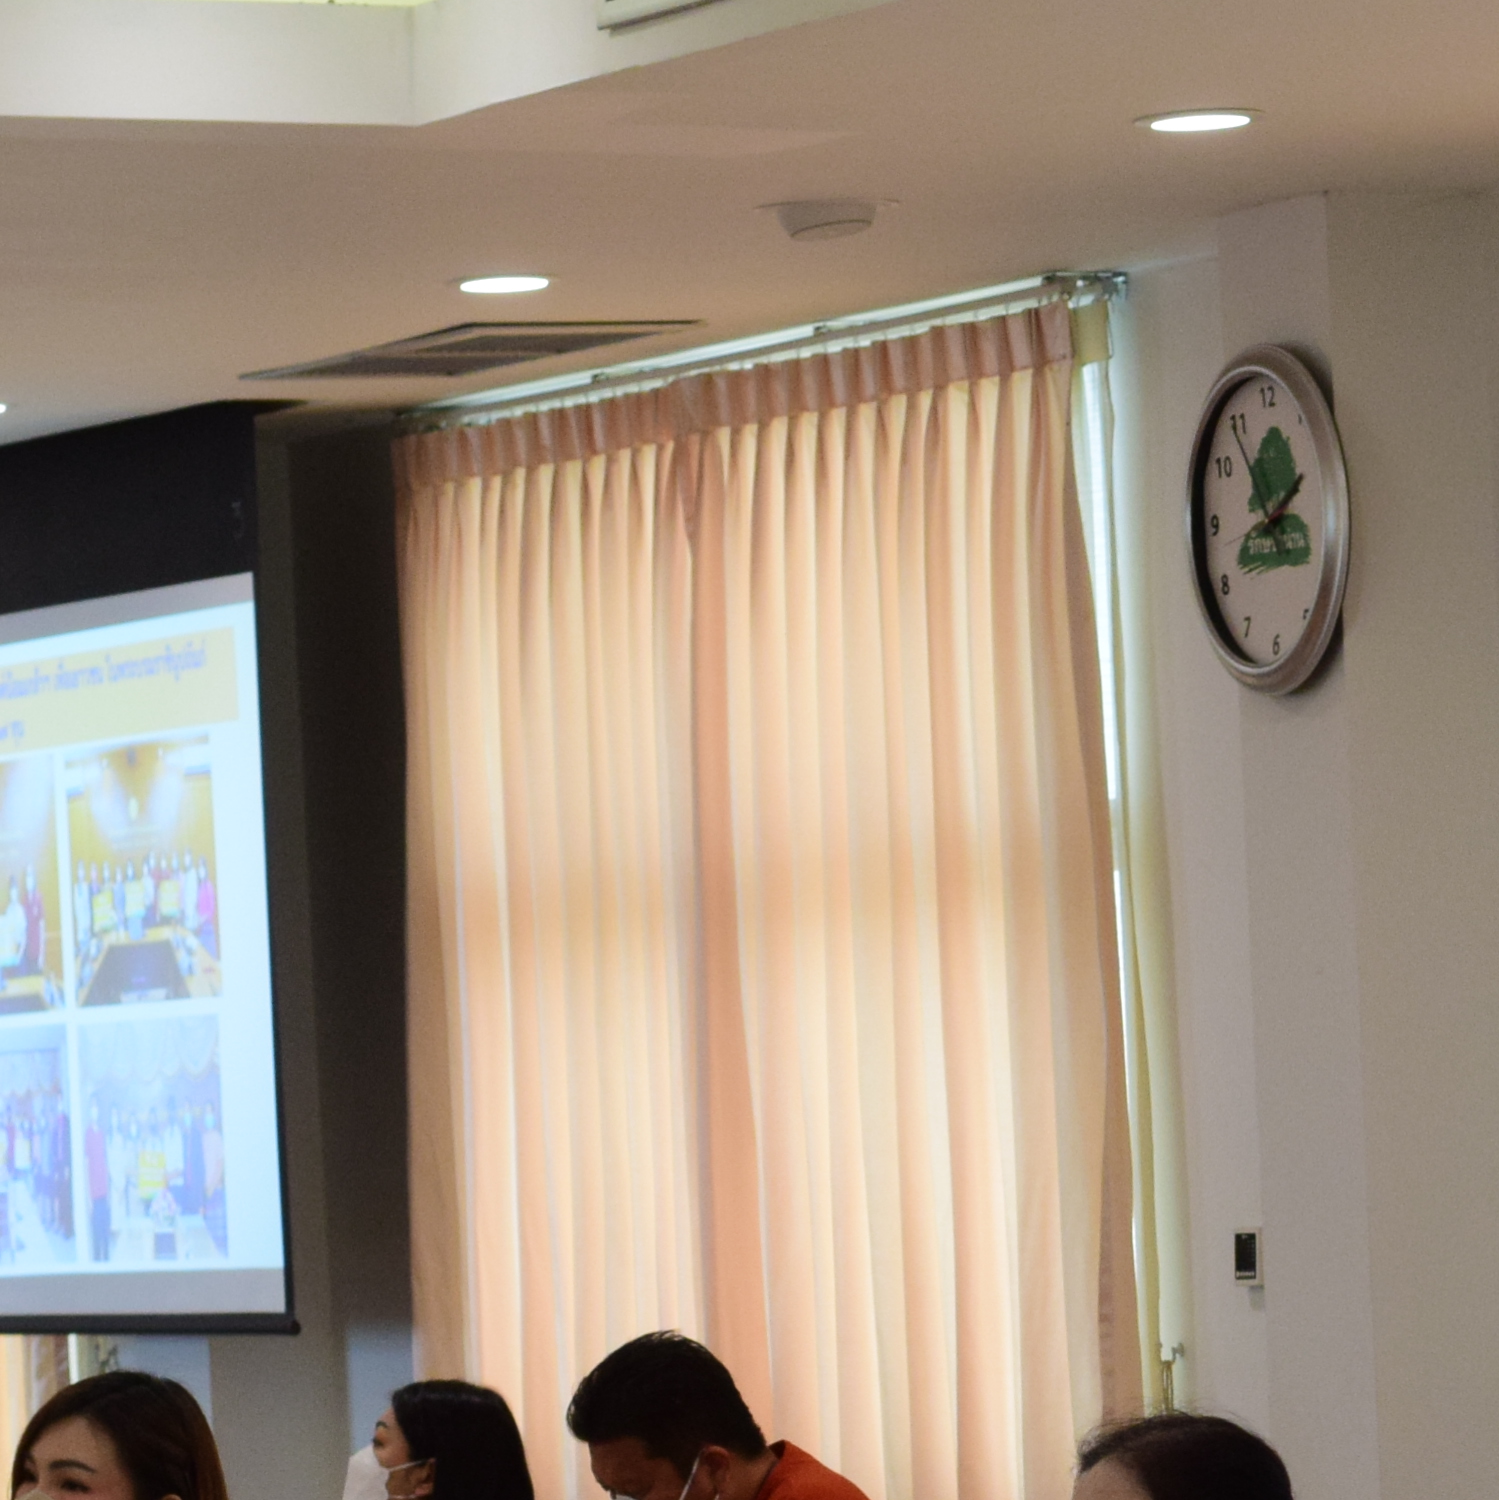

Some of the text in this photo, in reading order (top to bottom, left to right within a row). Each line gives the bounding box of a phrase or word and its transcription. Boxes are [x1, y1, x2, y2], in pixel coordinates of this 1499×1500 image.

[1260, 386, 1276, 408] 12
[1230, 413, 1246, 435] 11
[1215, 456, 1232, 479] 10
[1210, 515, 1220, 536] 9
[1221, 574, 1230, 595] 8
[1244, 617, 1251, 639] 7
[1272, 634, 1280, 655] 6
